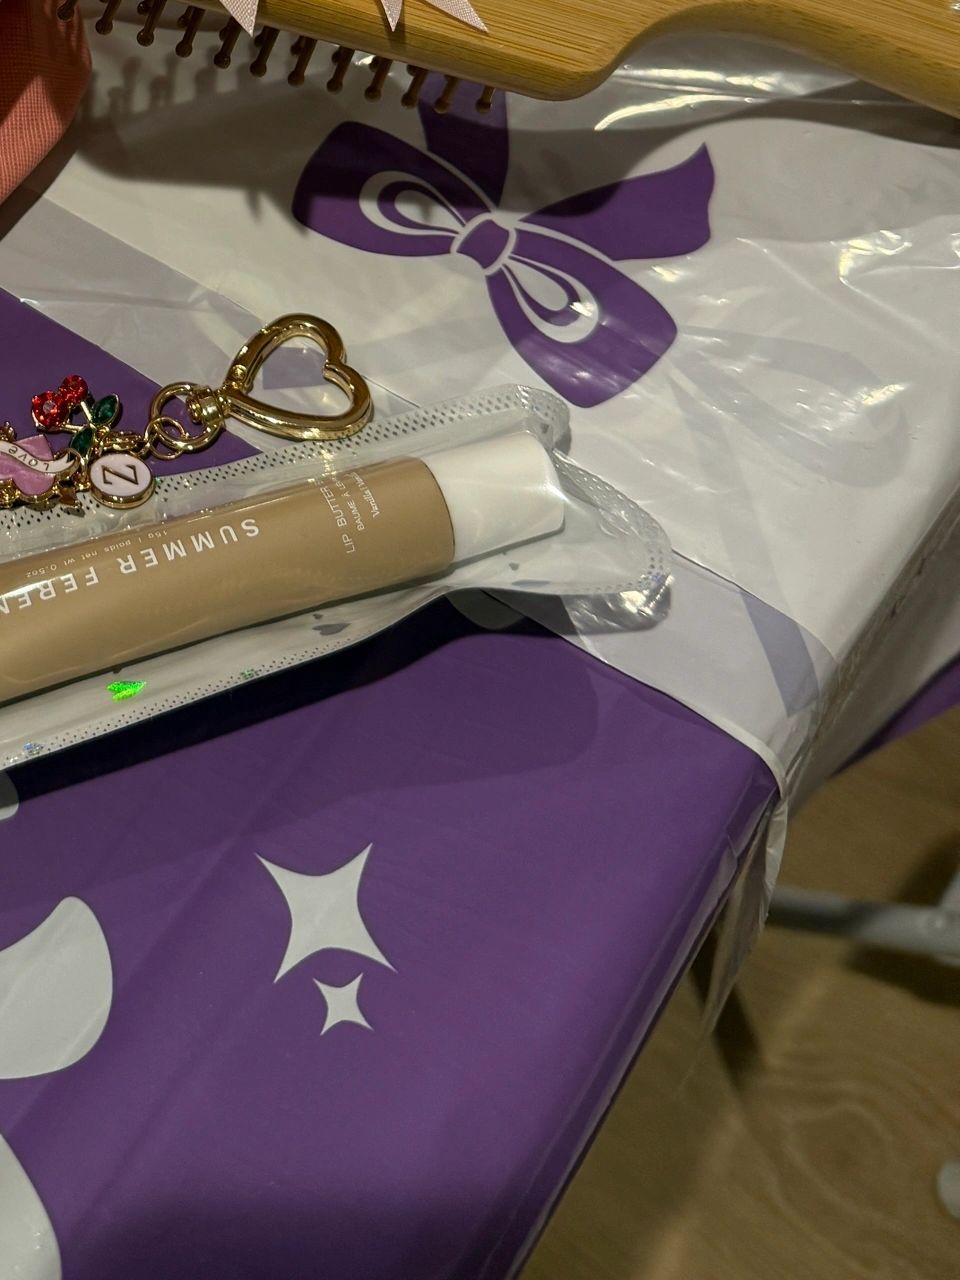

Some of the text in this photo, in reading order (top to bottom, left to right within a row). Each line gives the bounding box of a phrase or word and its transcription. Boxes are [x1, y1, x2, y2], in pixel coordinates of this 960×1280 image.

[320, 485, 347, 528] BUTTER
[347, 499, 365, 531] BAUME
[362, 488, 380, 518] Vanilla
[81, 550, 98, 561] net
[116, 518, 260, 574] SUMMER
[342, 533, 356, 554] LIP
[26, 563, 57, 578] 0.5oz
[63, 557, 76, 567] wt
